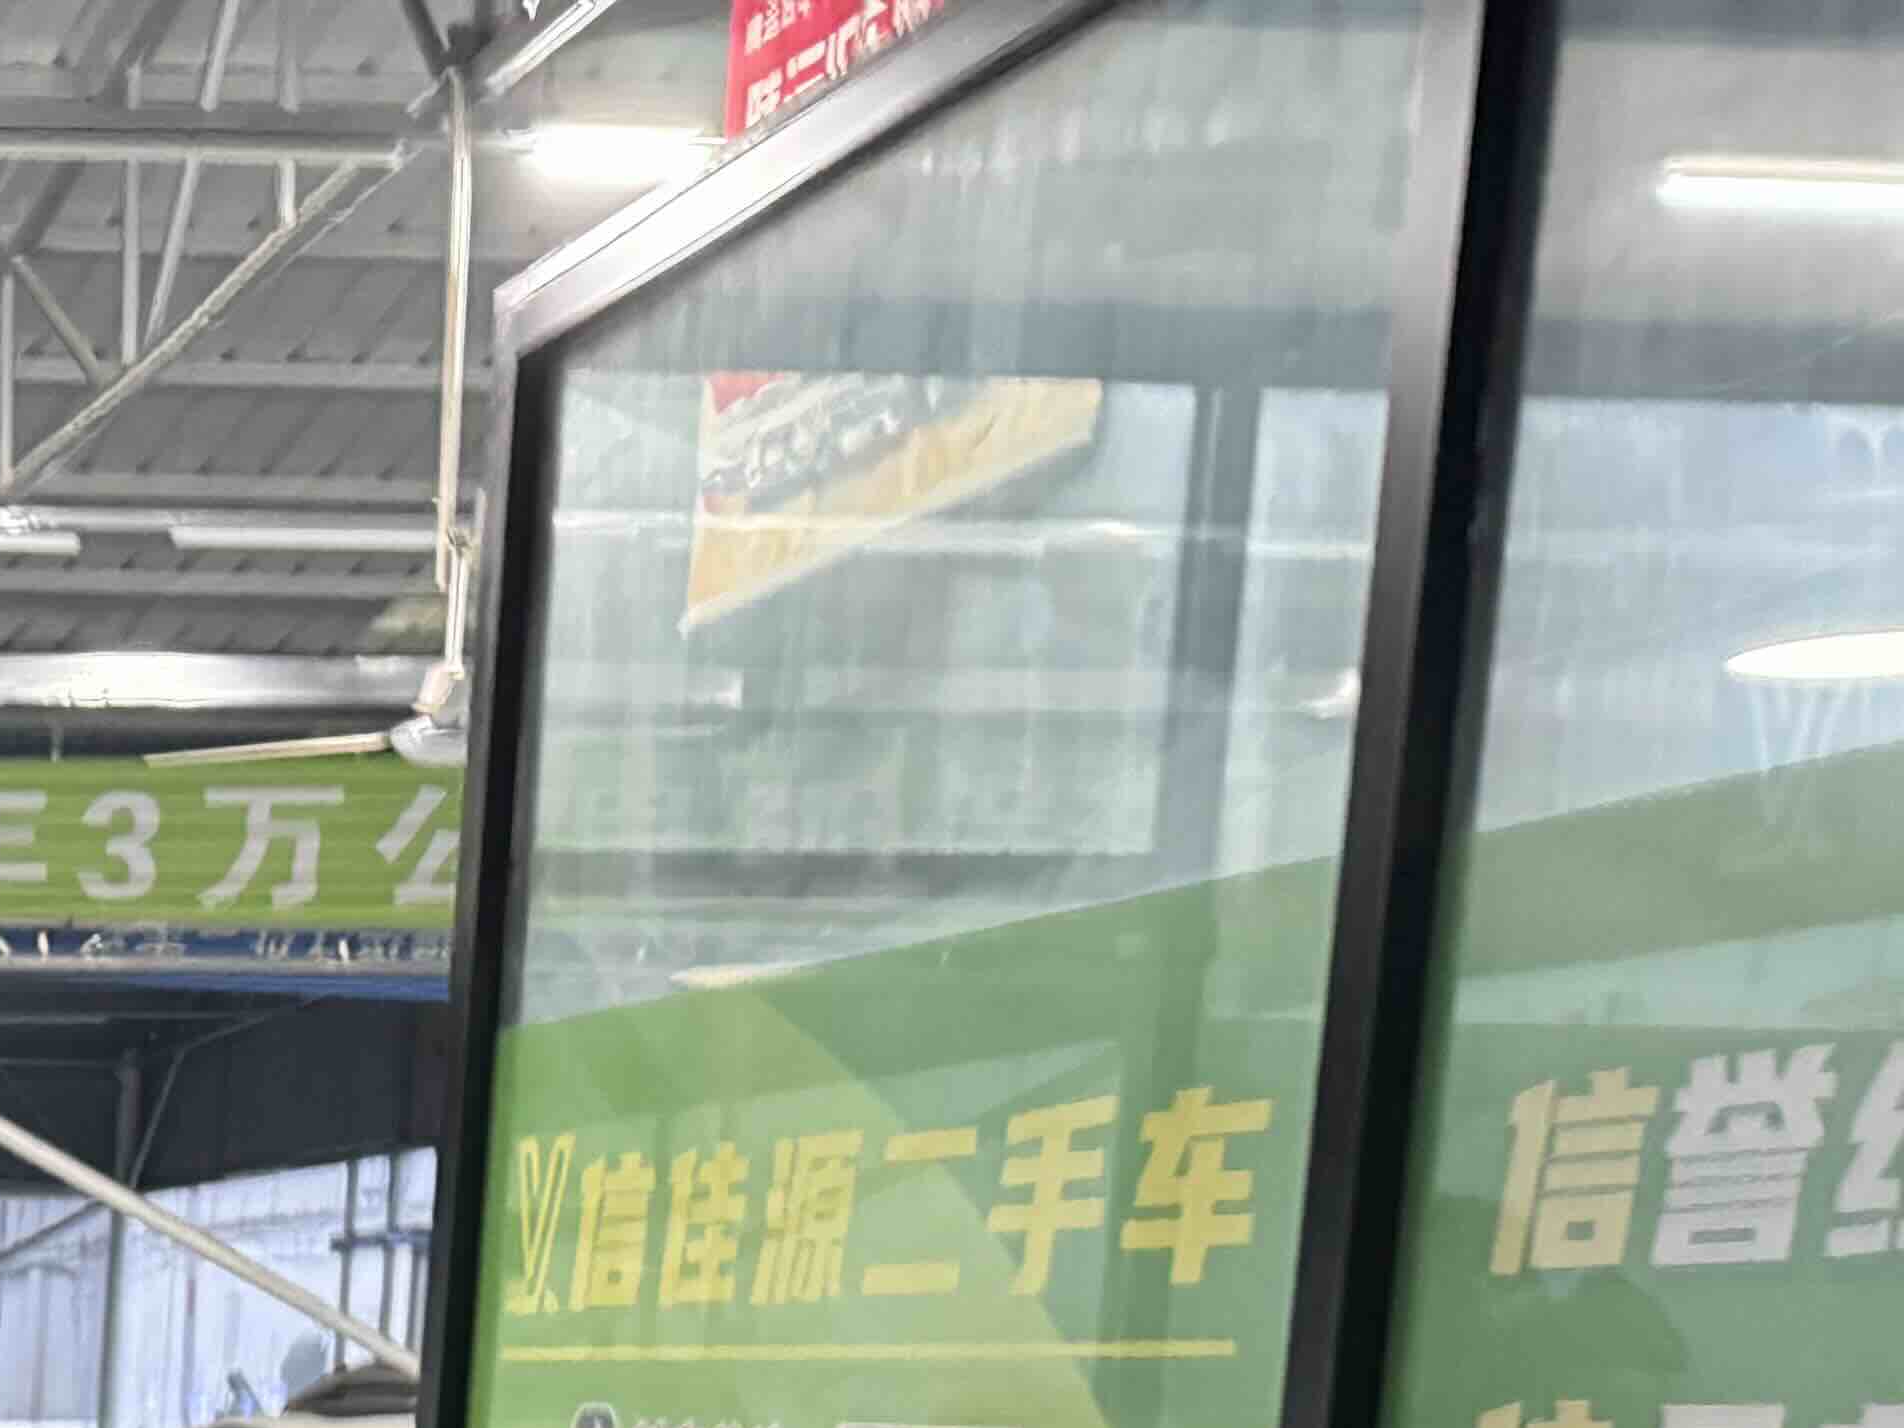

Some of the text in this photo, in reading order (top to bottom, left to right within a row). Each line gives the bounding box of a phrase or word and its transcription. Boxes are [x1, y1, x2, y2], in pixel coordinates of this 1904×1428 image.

[568, 1086, 1275, 1312] 信佳源二手车
